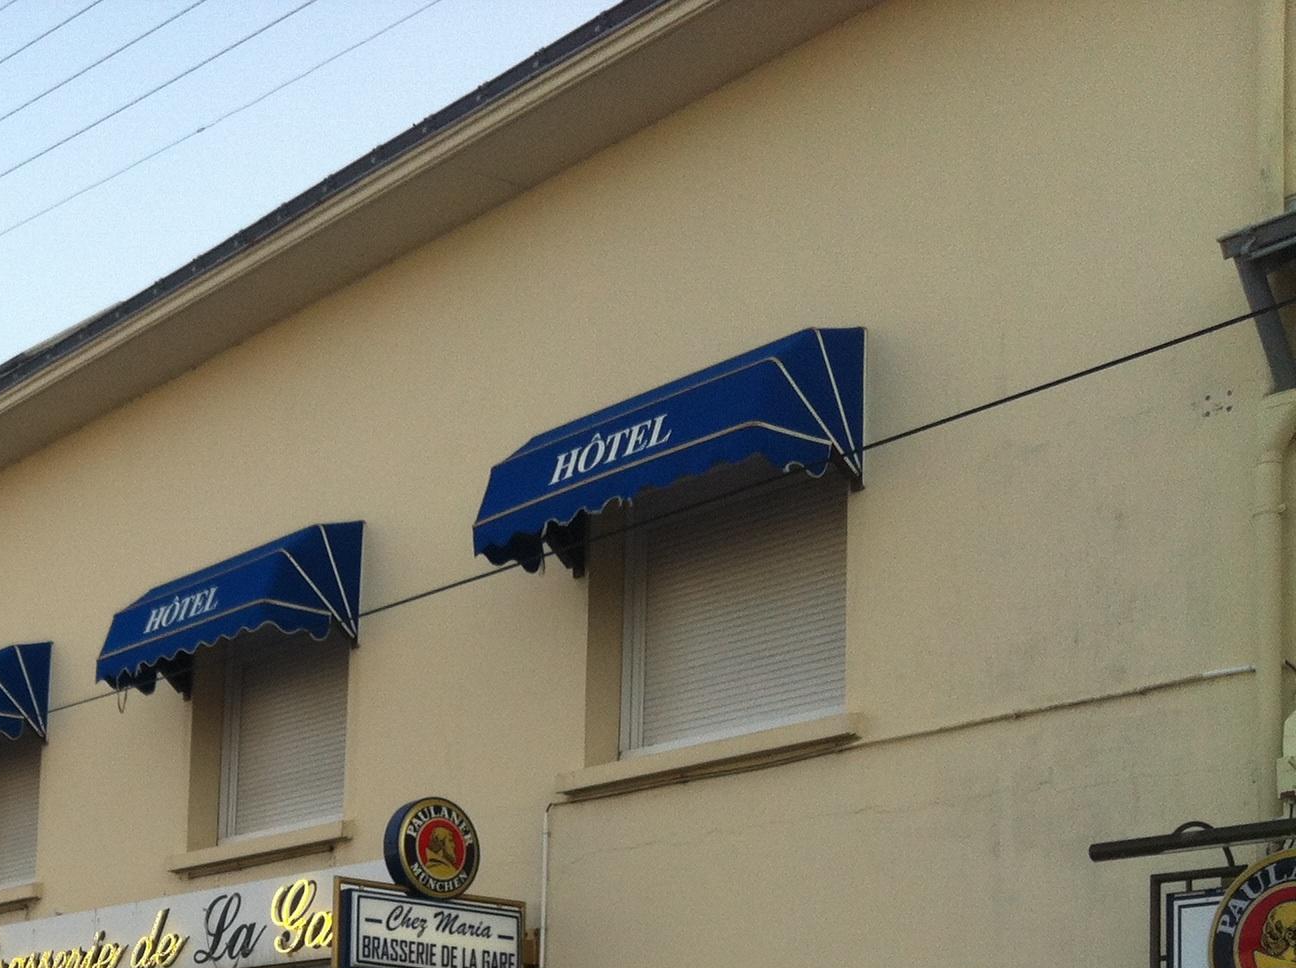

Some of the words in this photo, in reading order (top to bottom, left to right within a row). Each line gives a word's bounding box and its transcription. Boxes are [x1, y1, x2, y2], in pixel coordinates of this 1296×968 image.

[548, 413, 672, 486] HÔTEL
[143, 586, 218, 634] HÔTEL
[406, 806, 473, 846] PAULANER
[193, 891, 266, 964] La
[270, 879, 333, 954] Ga
[386, 904, 428, 938] Chez
[433, 910, 493, 940] Maria
[361, 935, 437, 967] BRASSERIE
[441, 944, 458, 968] DE
